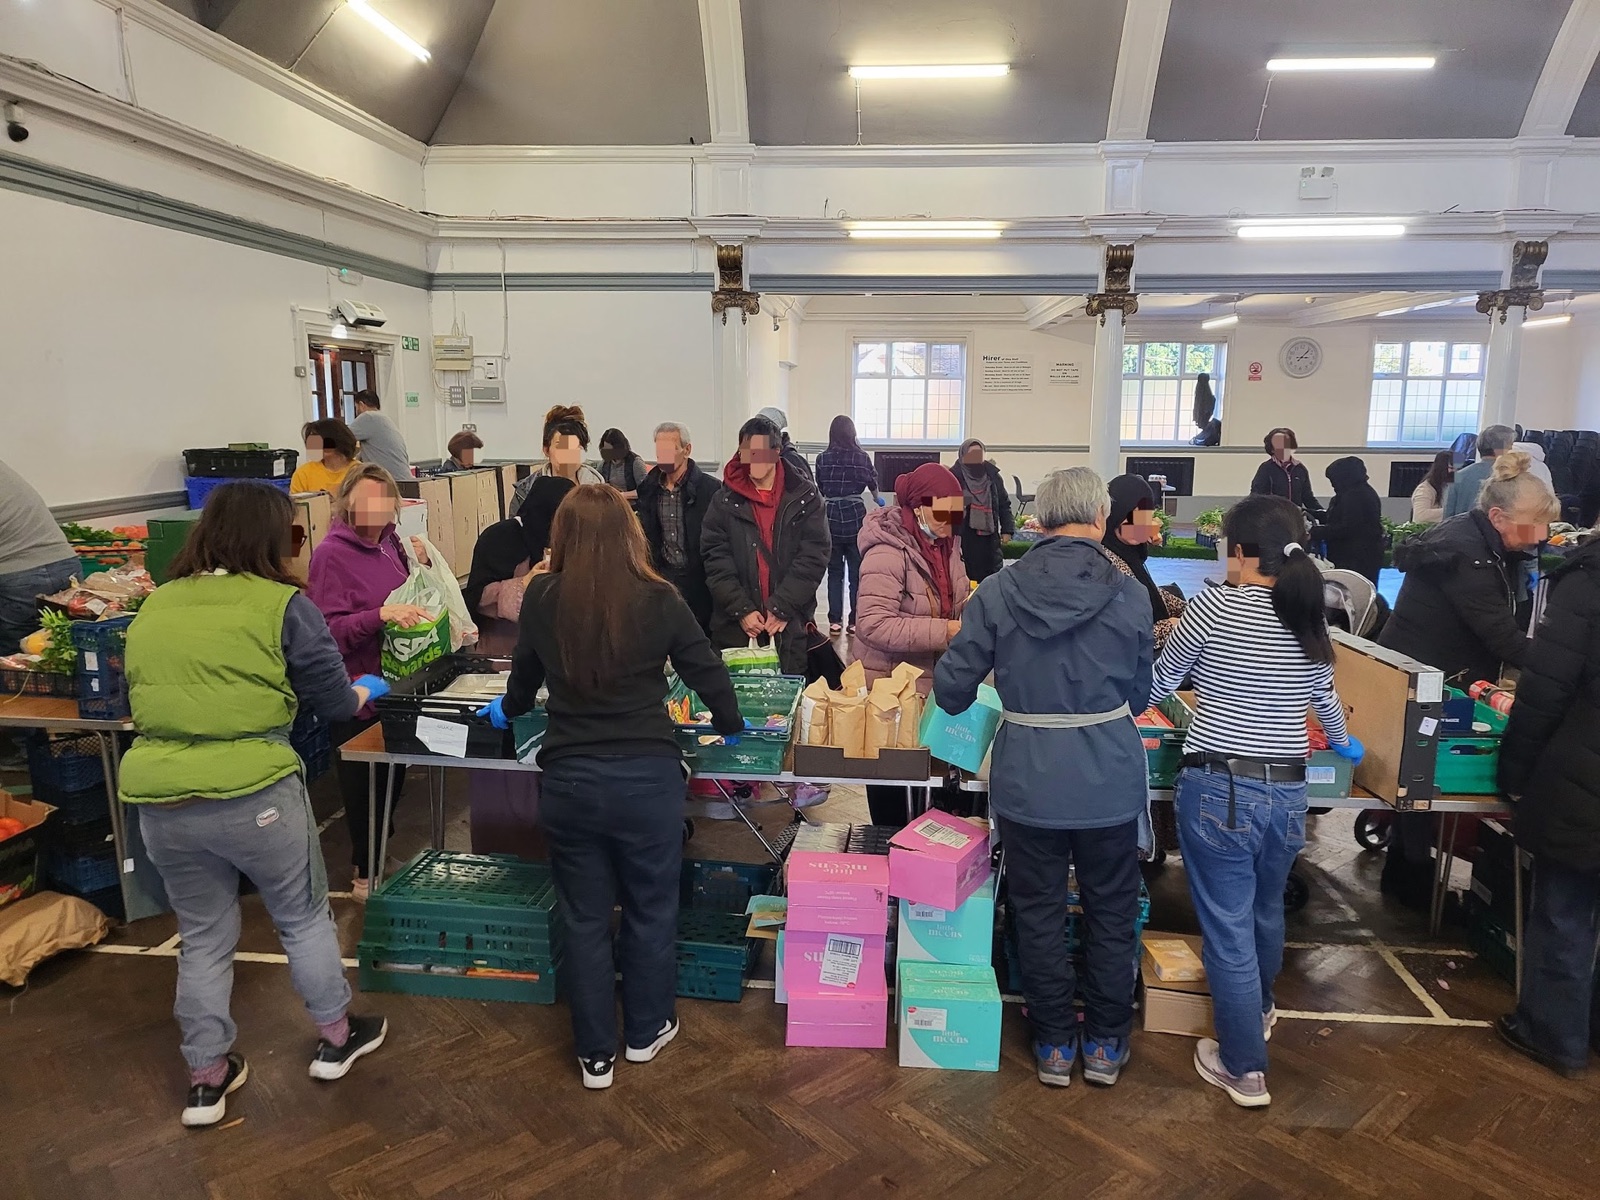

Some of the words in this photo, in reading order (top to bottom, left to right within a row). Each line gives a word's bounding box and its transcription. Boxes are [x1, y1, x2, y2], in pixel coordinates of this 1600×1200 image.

[382, 626, 440, 662] ASDA
[381, 646, 442, 676] Rewards
[955, 724, 972, 734] little
